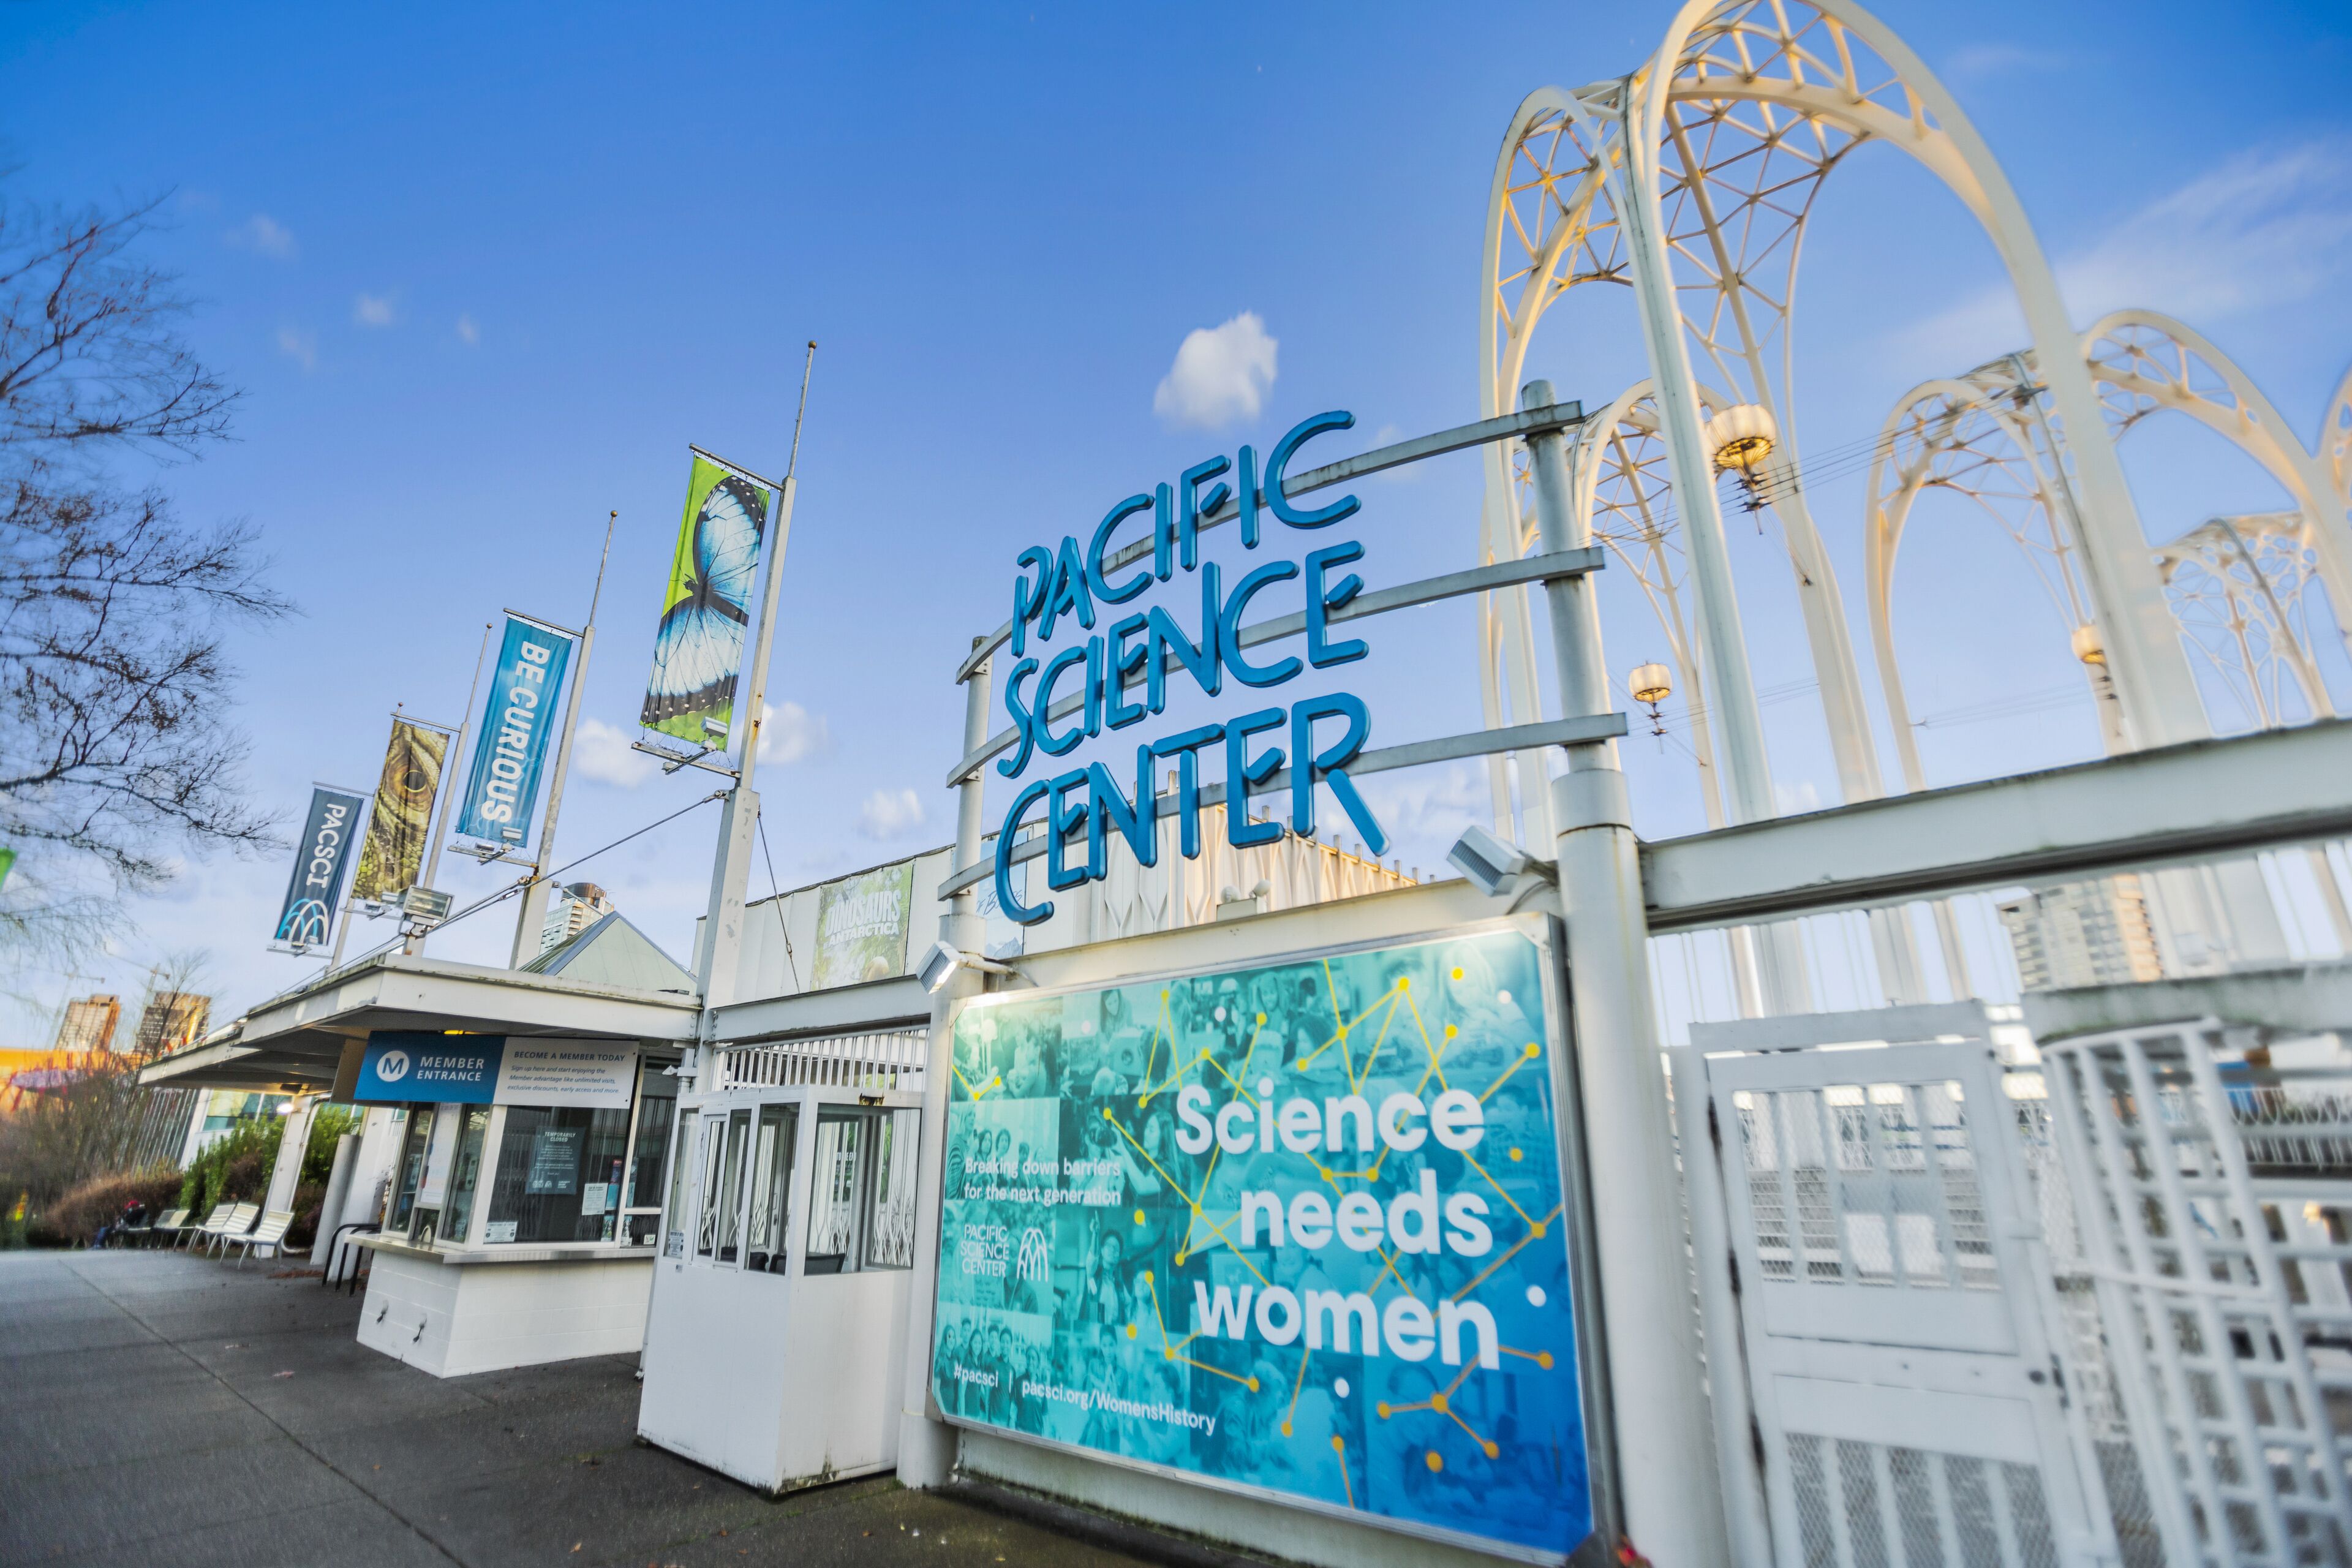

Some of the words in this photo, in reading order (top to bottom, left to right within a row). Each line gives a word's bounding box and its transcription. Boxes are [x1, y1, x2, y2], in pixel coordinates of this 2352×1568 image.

[1011, 410, 1362, 657] PACIFIC
[514, 640, 551, 684] BE
[997, 540, 1369, 778] SCIENCE
[480, 686, 539, 824] CURIOUS
[995, 692, 1390, 926] CENTER
[306, 803, 347, 889] PACSCI
[824, 889, 902, 938] DINOSAURS
[829, 922, 900, 947] ANTARCTICA
[382, 1058, 404, 1074] M
[417, 1071, 482, 1081] ENTRANCE
[420, 1057, 484, 1069] MEMBER
[1175, 1077, 1485, 1155] Science
[965, 1156, 1019, 1179] Breaking
[1022, 1158, 1060, 1175] down
[1063, 1156, 1121, 1176] barriers
[964, 1183, 981, 1199] for
[986, 1183, 1007, 1200] the
[1011, 1186, 1040, 1203] next
[1044, 1186, 1121, 1207] generation
[1240, 1168, 1493, 1257] needs
[960, 1240, 1010, 1261] SCIENCE
[964, 1224, 1008, 1243] PACIFIC
[962, 1257, 1006, 1278] CENTER
[1193, 1280, 1499, 1370] women
[954, 1363, 999, 1389] #pacsci
[1022, 1379, 1216, 1436] pacsci.org/WomensHistory
